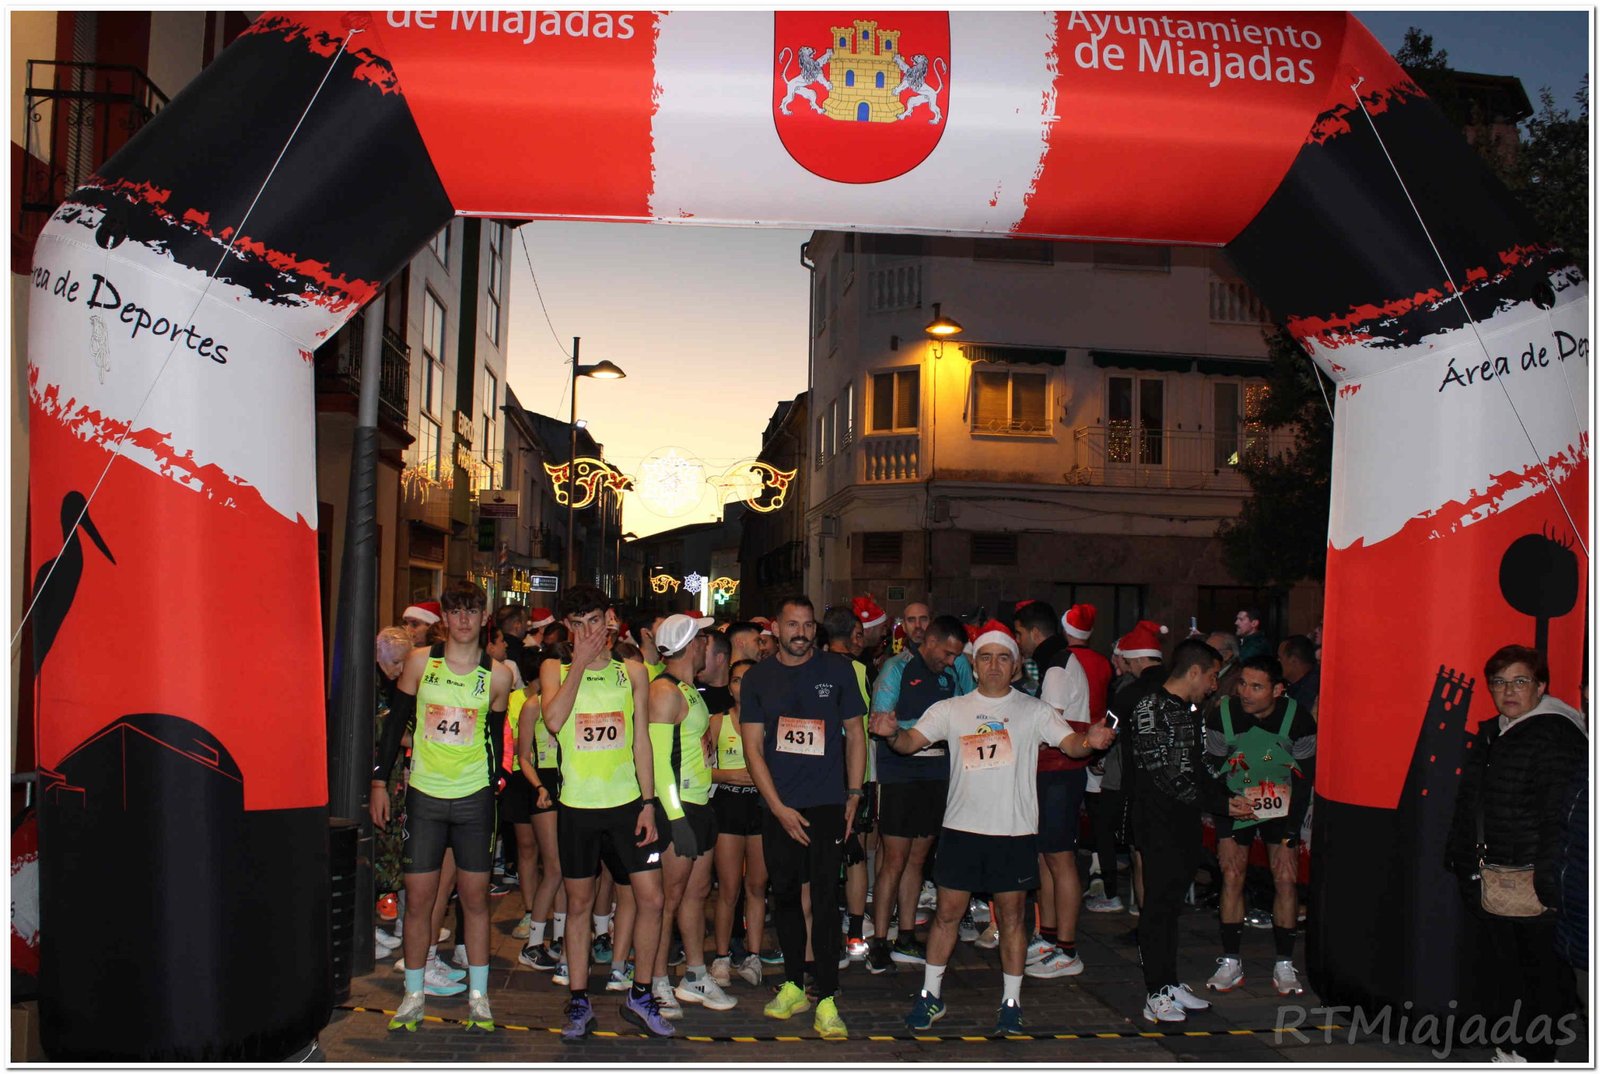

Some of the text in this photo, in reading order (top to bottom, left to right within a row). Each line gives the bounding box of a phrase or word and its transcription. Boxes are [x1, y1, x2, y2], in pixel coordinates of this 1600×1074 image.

[450, 11, 635, 44] Miajadas
[1067, 11, 1323, 50] Ayuntamiento
[1074, 33, 1316, 88] de Miajadas
[31, 265, 229, 365] rea de Deportes
[1438, 357, 1510, 392] Área
[1521, 342, 1549, 371] de
[436, 719, 461, 736] 44
[583, 725, 618, 742] 370
[784, 730, 814, 746] 431
[976, 743, 998, 760] 17
[741, 786, 758, 794] PR
[1253, 797, 1282, 811] 580
